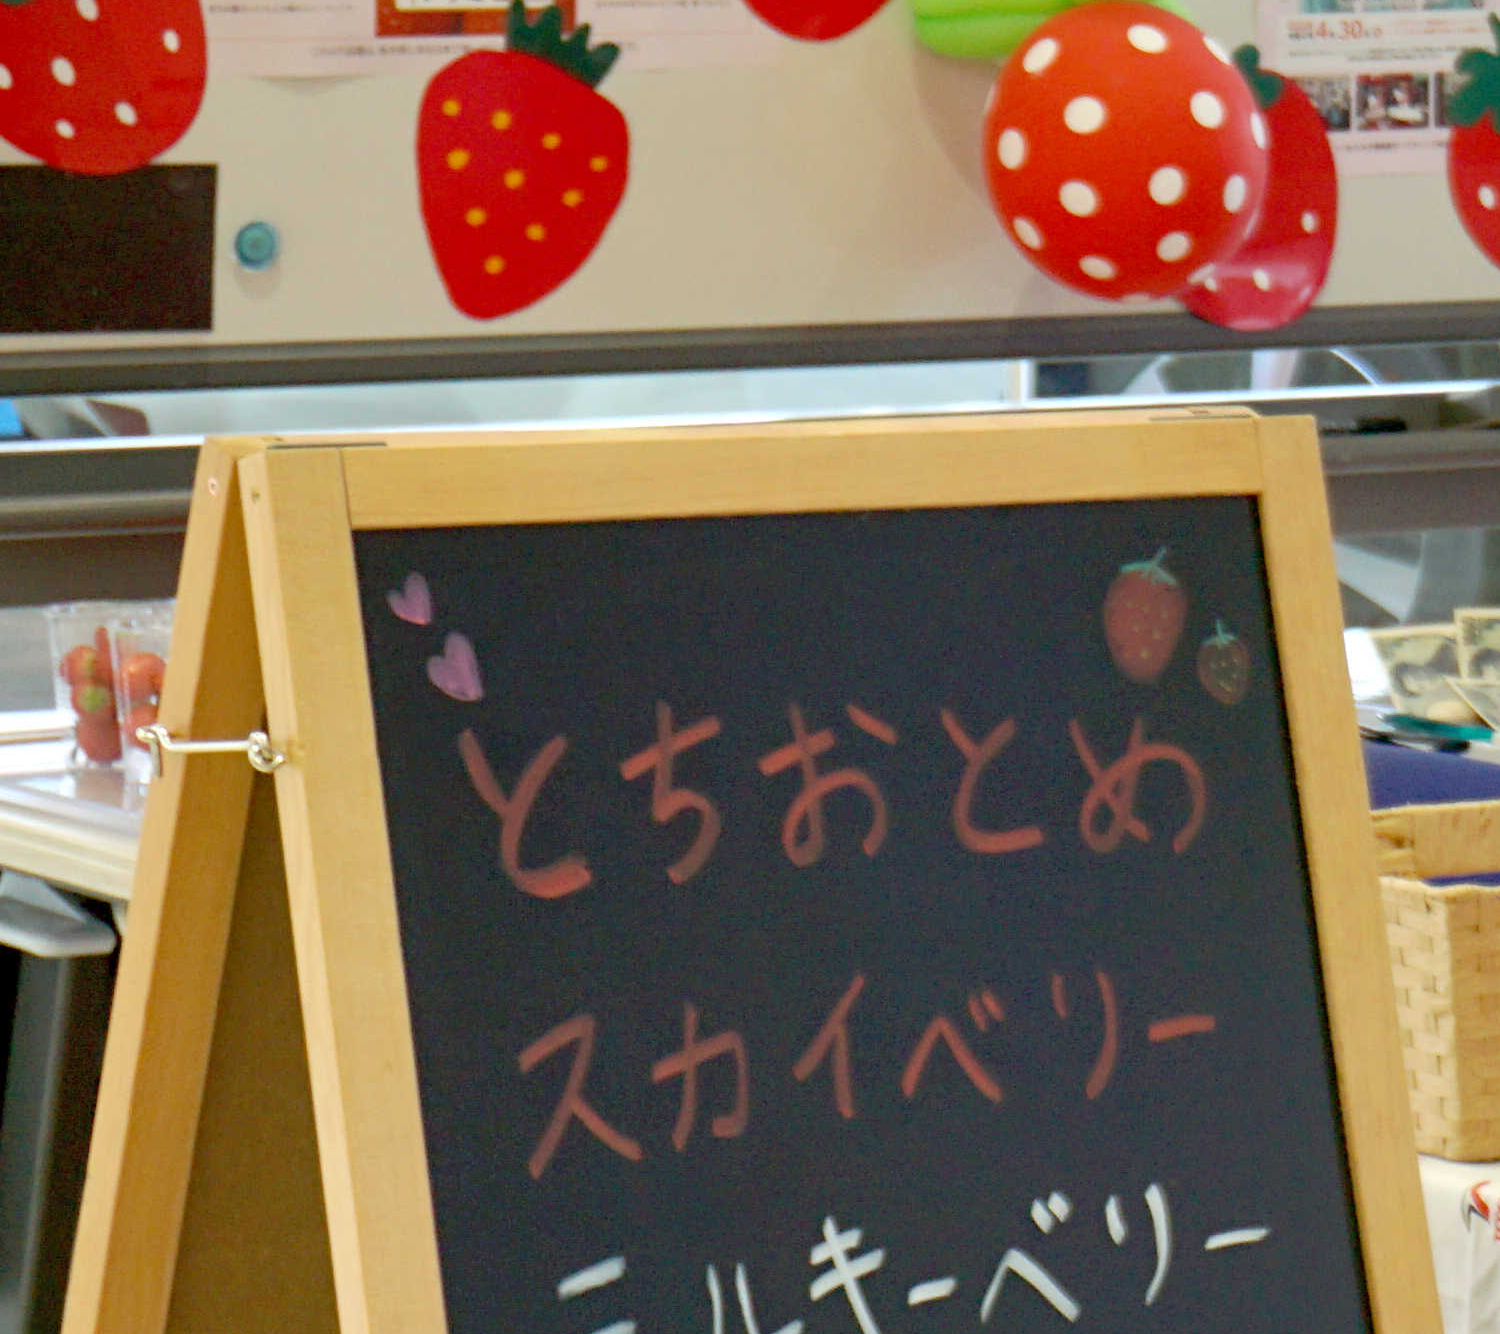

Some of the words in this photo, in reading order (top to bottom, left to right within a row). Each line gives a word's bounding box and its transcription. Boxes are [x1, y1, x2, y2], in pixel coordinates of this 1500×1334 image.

[458, 699, 1208, 902] とちおとめ
[518, 971, 1216, 1180] スカイベリー
